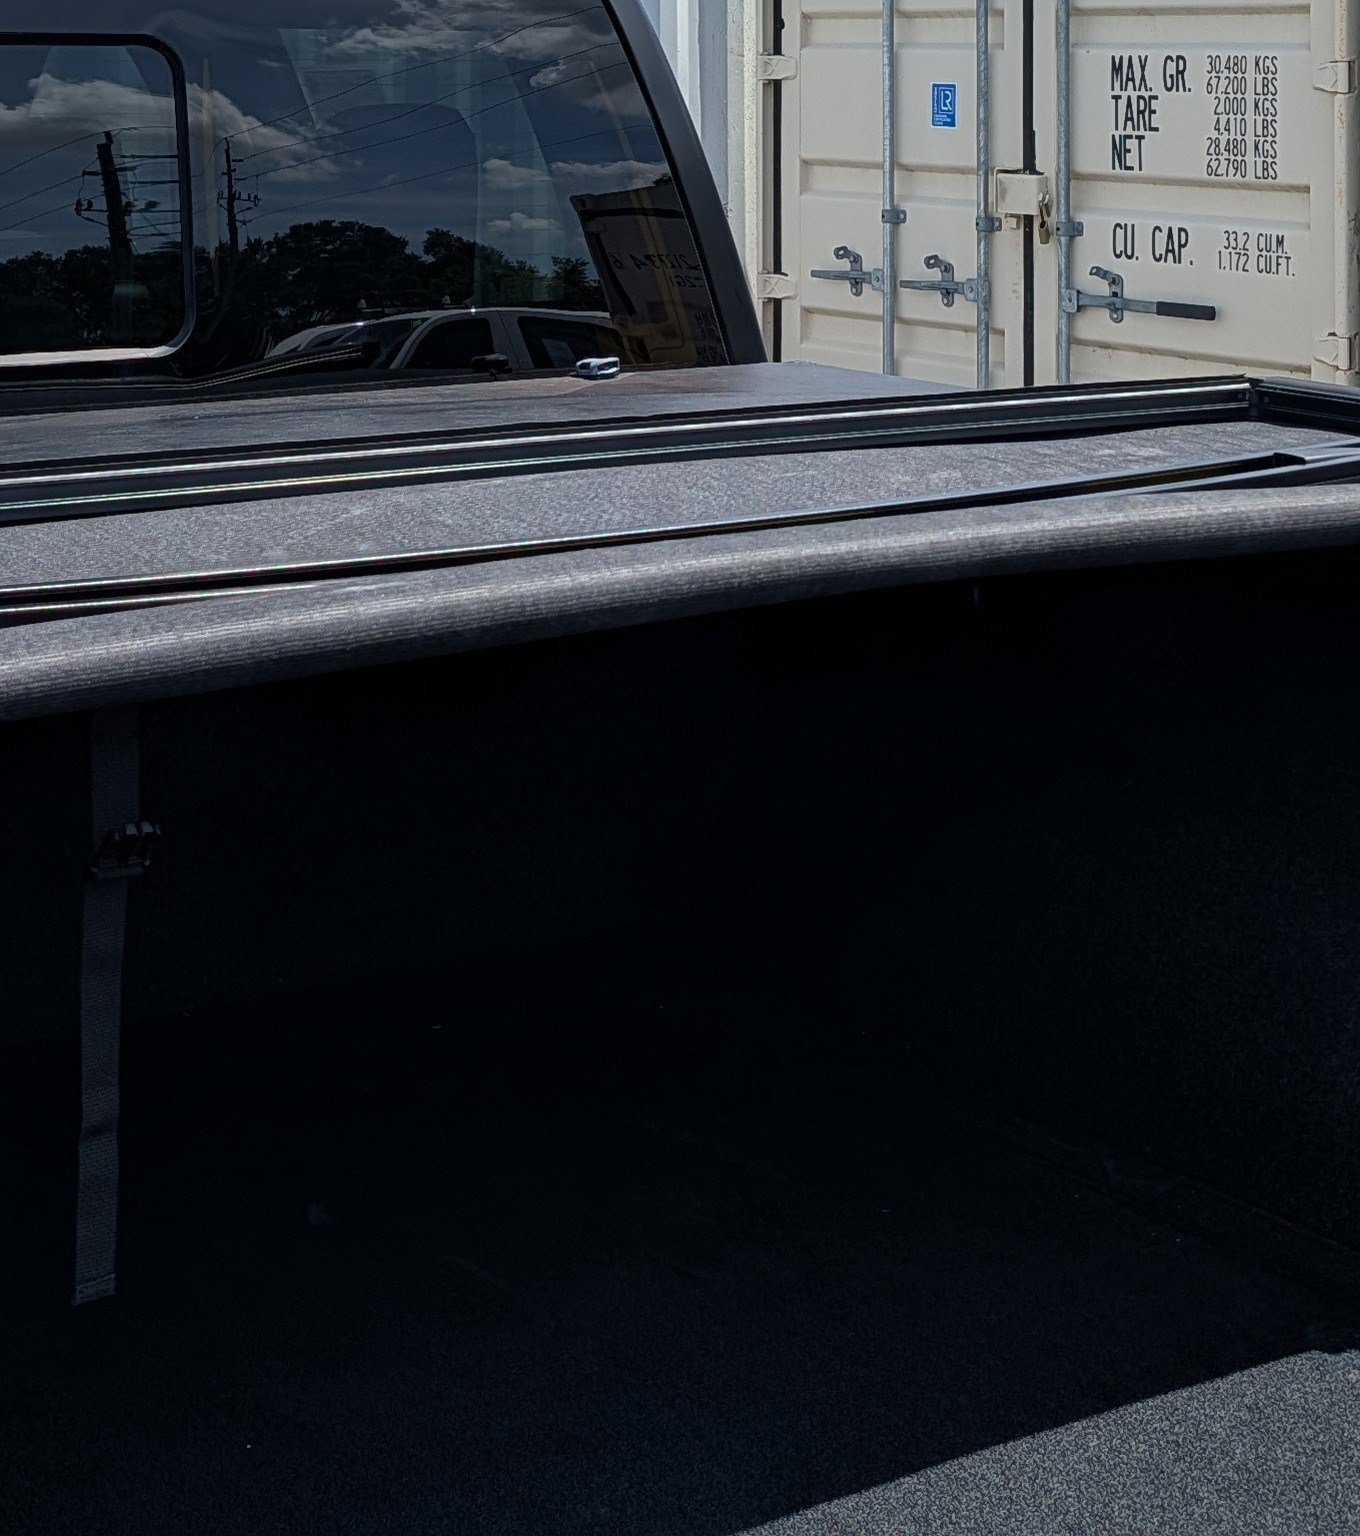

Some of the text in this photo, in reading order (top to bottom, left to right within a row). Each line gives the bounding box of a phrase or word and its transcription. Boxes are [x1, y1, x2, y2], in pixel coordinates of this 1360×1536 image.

[1111, 54, 1192, 93] MAX. GR.
[1253, 55, 1278, 75] KGS
[1253, 76, 1278, 96] LBS
[1111, 95, 1160, 132] TARE
[1253, 97, 1278, 117] KGS
[1253, 118, 1278, 138] LBS
[1111, 134, 1146, 171] NET
[1253, 139, 1278, 159] KGS
[1253, 160, 1278, 180] LBS
[1112, 222, 1194, 265] CU. CAP.
[1223, 230, 1250, 252] 33.2
